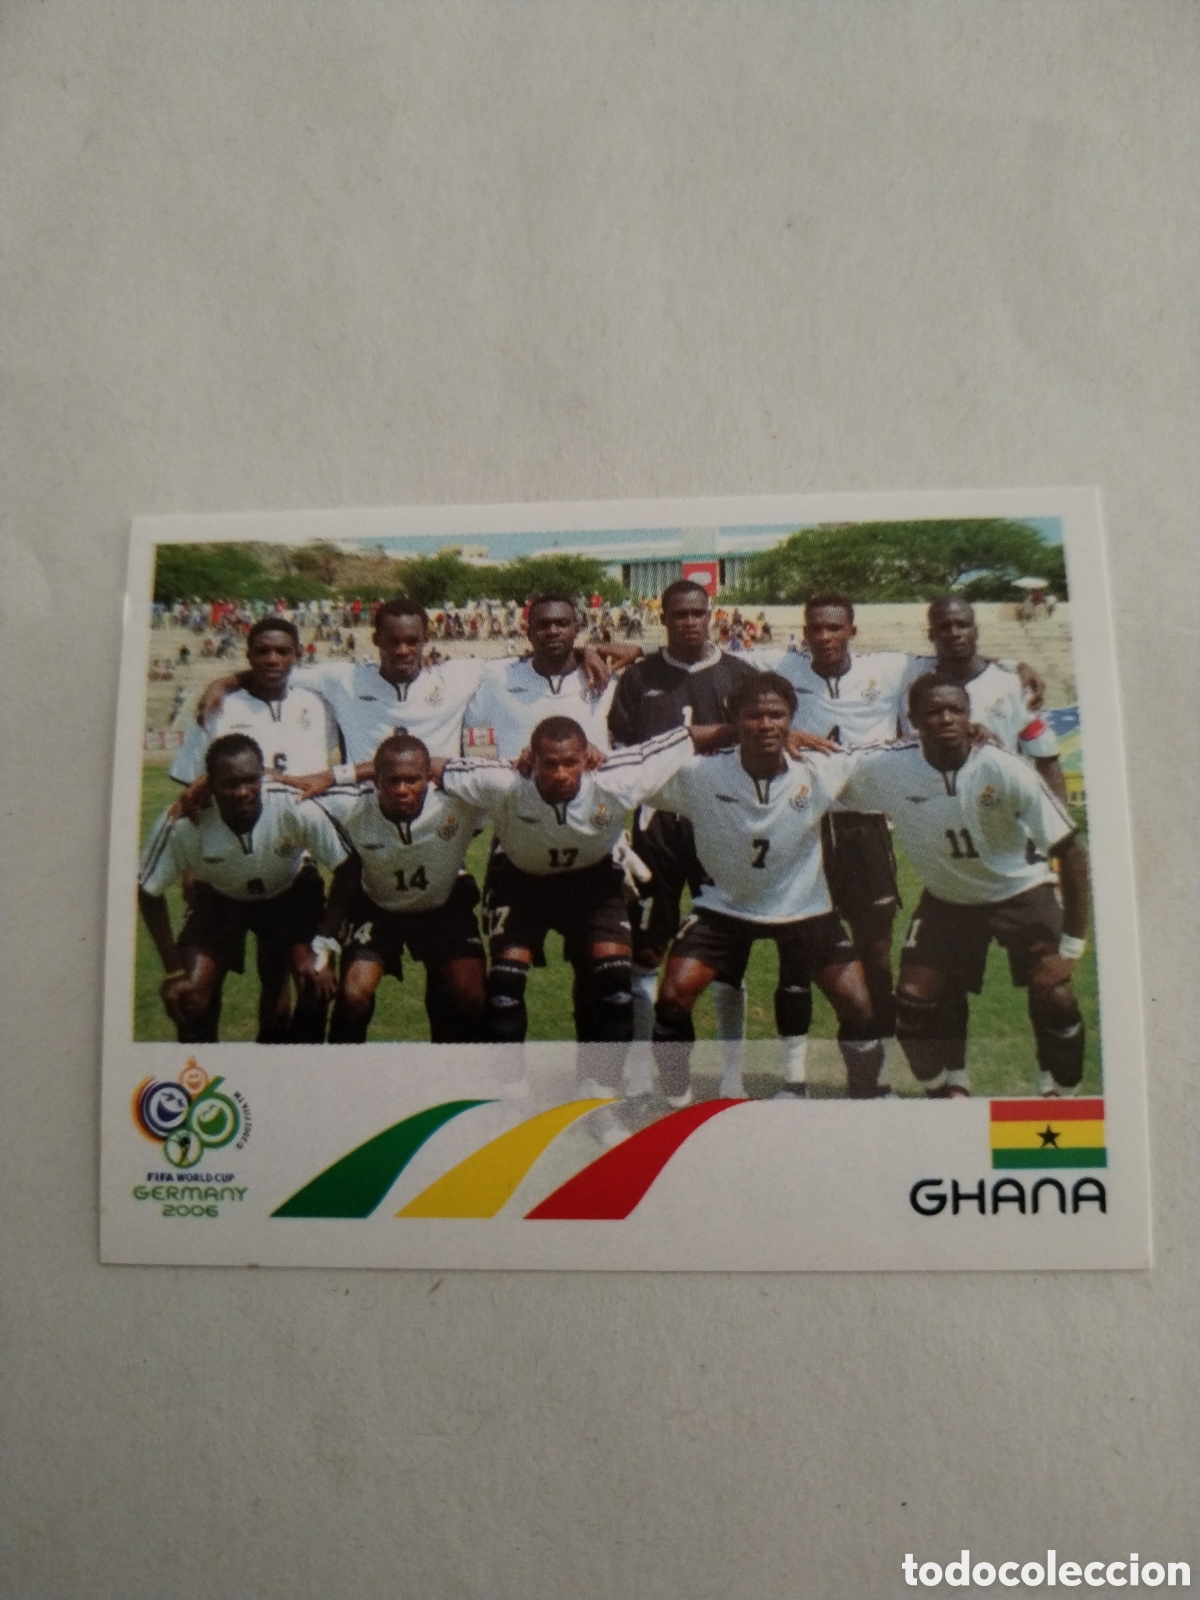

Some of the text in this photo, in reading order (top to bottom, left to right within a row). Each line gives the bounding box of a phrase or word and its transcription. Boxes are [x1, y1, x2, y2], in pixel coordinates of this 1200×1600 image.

[751, 838, 770, 868] 7
[944, 828, 979, 858] 11
[548, 847, 579, 868] 17
[394, 864, 429, 891] 14
[147, 1172, 235, 1183] FIFA WORLD CUP
[133, 1185, 248, 1201] GERMANY
[909, 1177, 1107, 1216] GHANA
[162, 1204, 220, 1218] 2006
